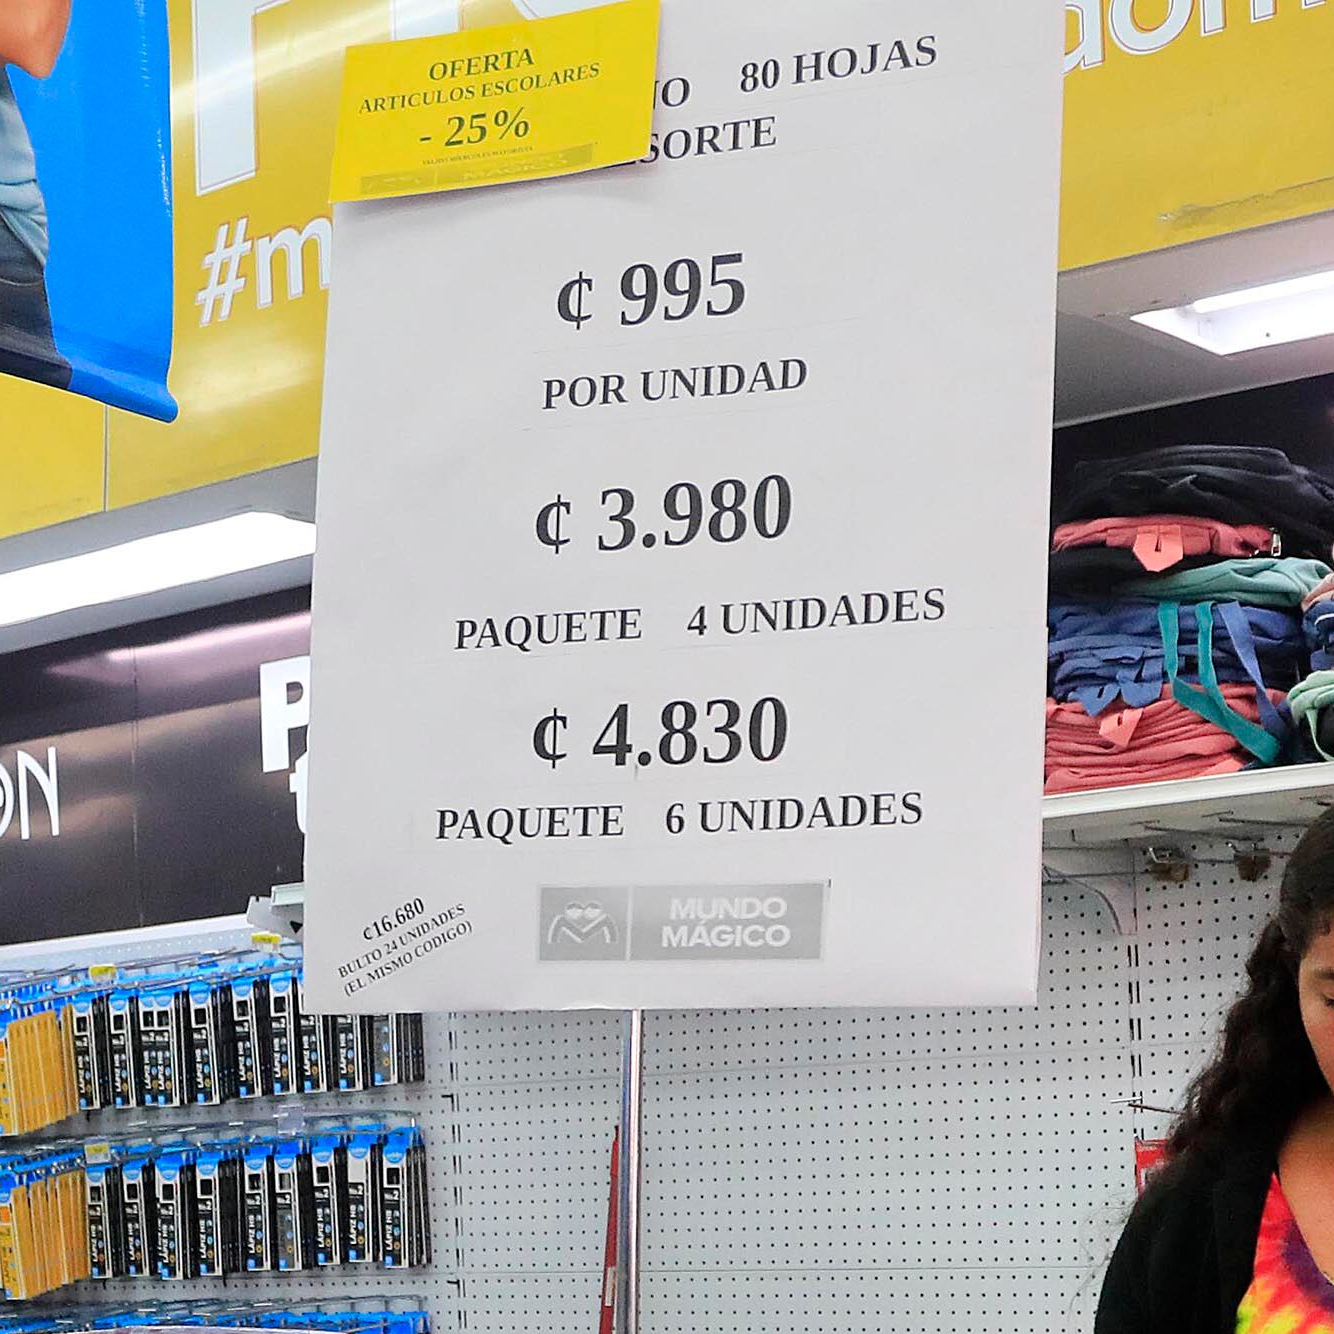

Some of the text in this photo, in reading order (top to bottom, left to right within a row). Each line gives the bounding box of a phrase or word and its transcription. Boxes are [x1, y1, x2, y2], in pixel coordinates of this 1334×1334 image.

[358, 62, 600, 114] ARTICULOS ESCOLARES
[429, 48, 534, 81] OFERTA
[740, 59, 779, 93] 80
[792, 35, 937, 85] HOJAS
[444, 107, 530, 147] 25%
[627, 116, 777, 165] SORTE
[195, 216, 333, 327] #m
[620, 252, 746, 327] 995
[542, 358, 807, 410] POR UNIDAD
[598, 474, 791, 551] 3.980
[454, 587, 945, 652] PAQUETE 4 UNIDADES
[593, 696, 788, 766] 4.830
[435, 792, 923, 845] PAQUETE 6 UNIDADES
[661, 916, 791, 949] MÁGICO
[670, 896, 787, 920] MUNDO
[338, 903, 466, 978] BULTO 24 UNIDADES
[344, 920, 473, 997] (EL MISMO CODIGO)
